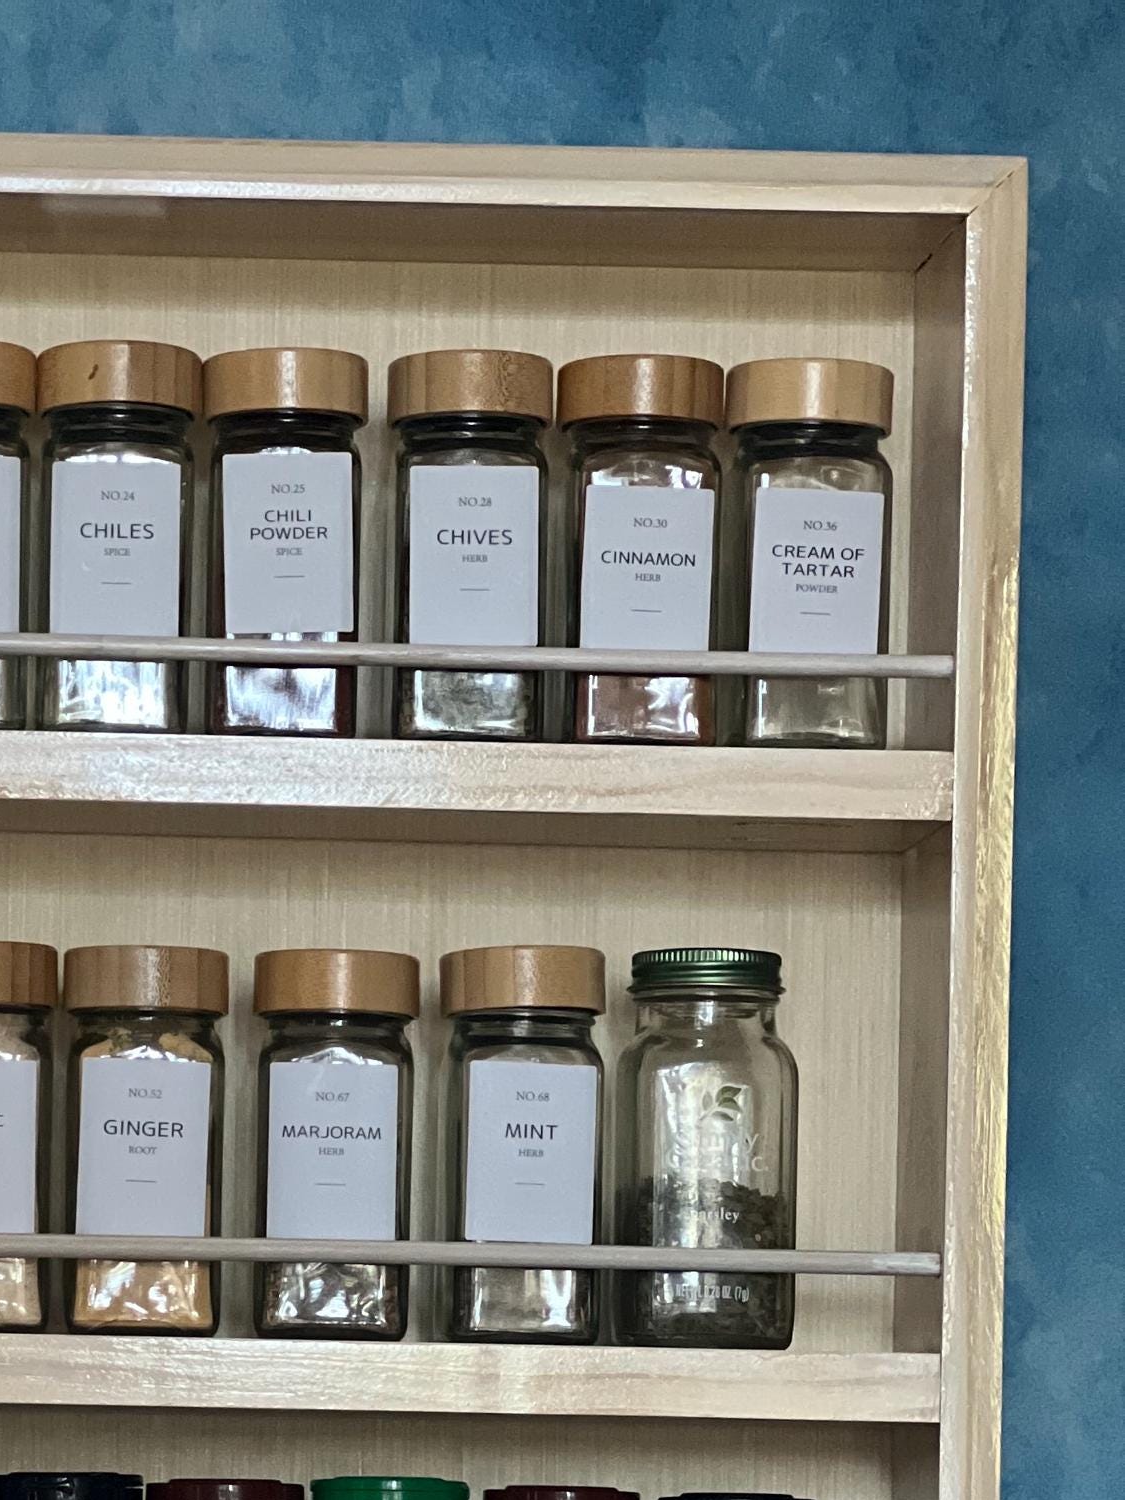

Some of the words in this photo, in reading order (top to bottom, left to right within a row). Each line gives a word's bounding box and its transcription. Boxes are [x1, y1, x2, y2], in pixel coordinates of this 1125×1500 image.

[263, 509, 312, 523] CHILI
[80, 522, 155, 539] CHILES
[249, 526, 328, 540] POWDER
[436, 529, 513, 546] CHIVES
[600, 550, 696, 567] CINNAMON
[771, 544, 835, 560] CREAM
[840, 547, 866, 561] OF
[781, 562, 855, 578] TARTAR
[103, 1119, 184, 1138] GINGER
[282, 1125, 382, 1140] MARJORAM
[504, 1122, 558, 1140] MINT
